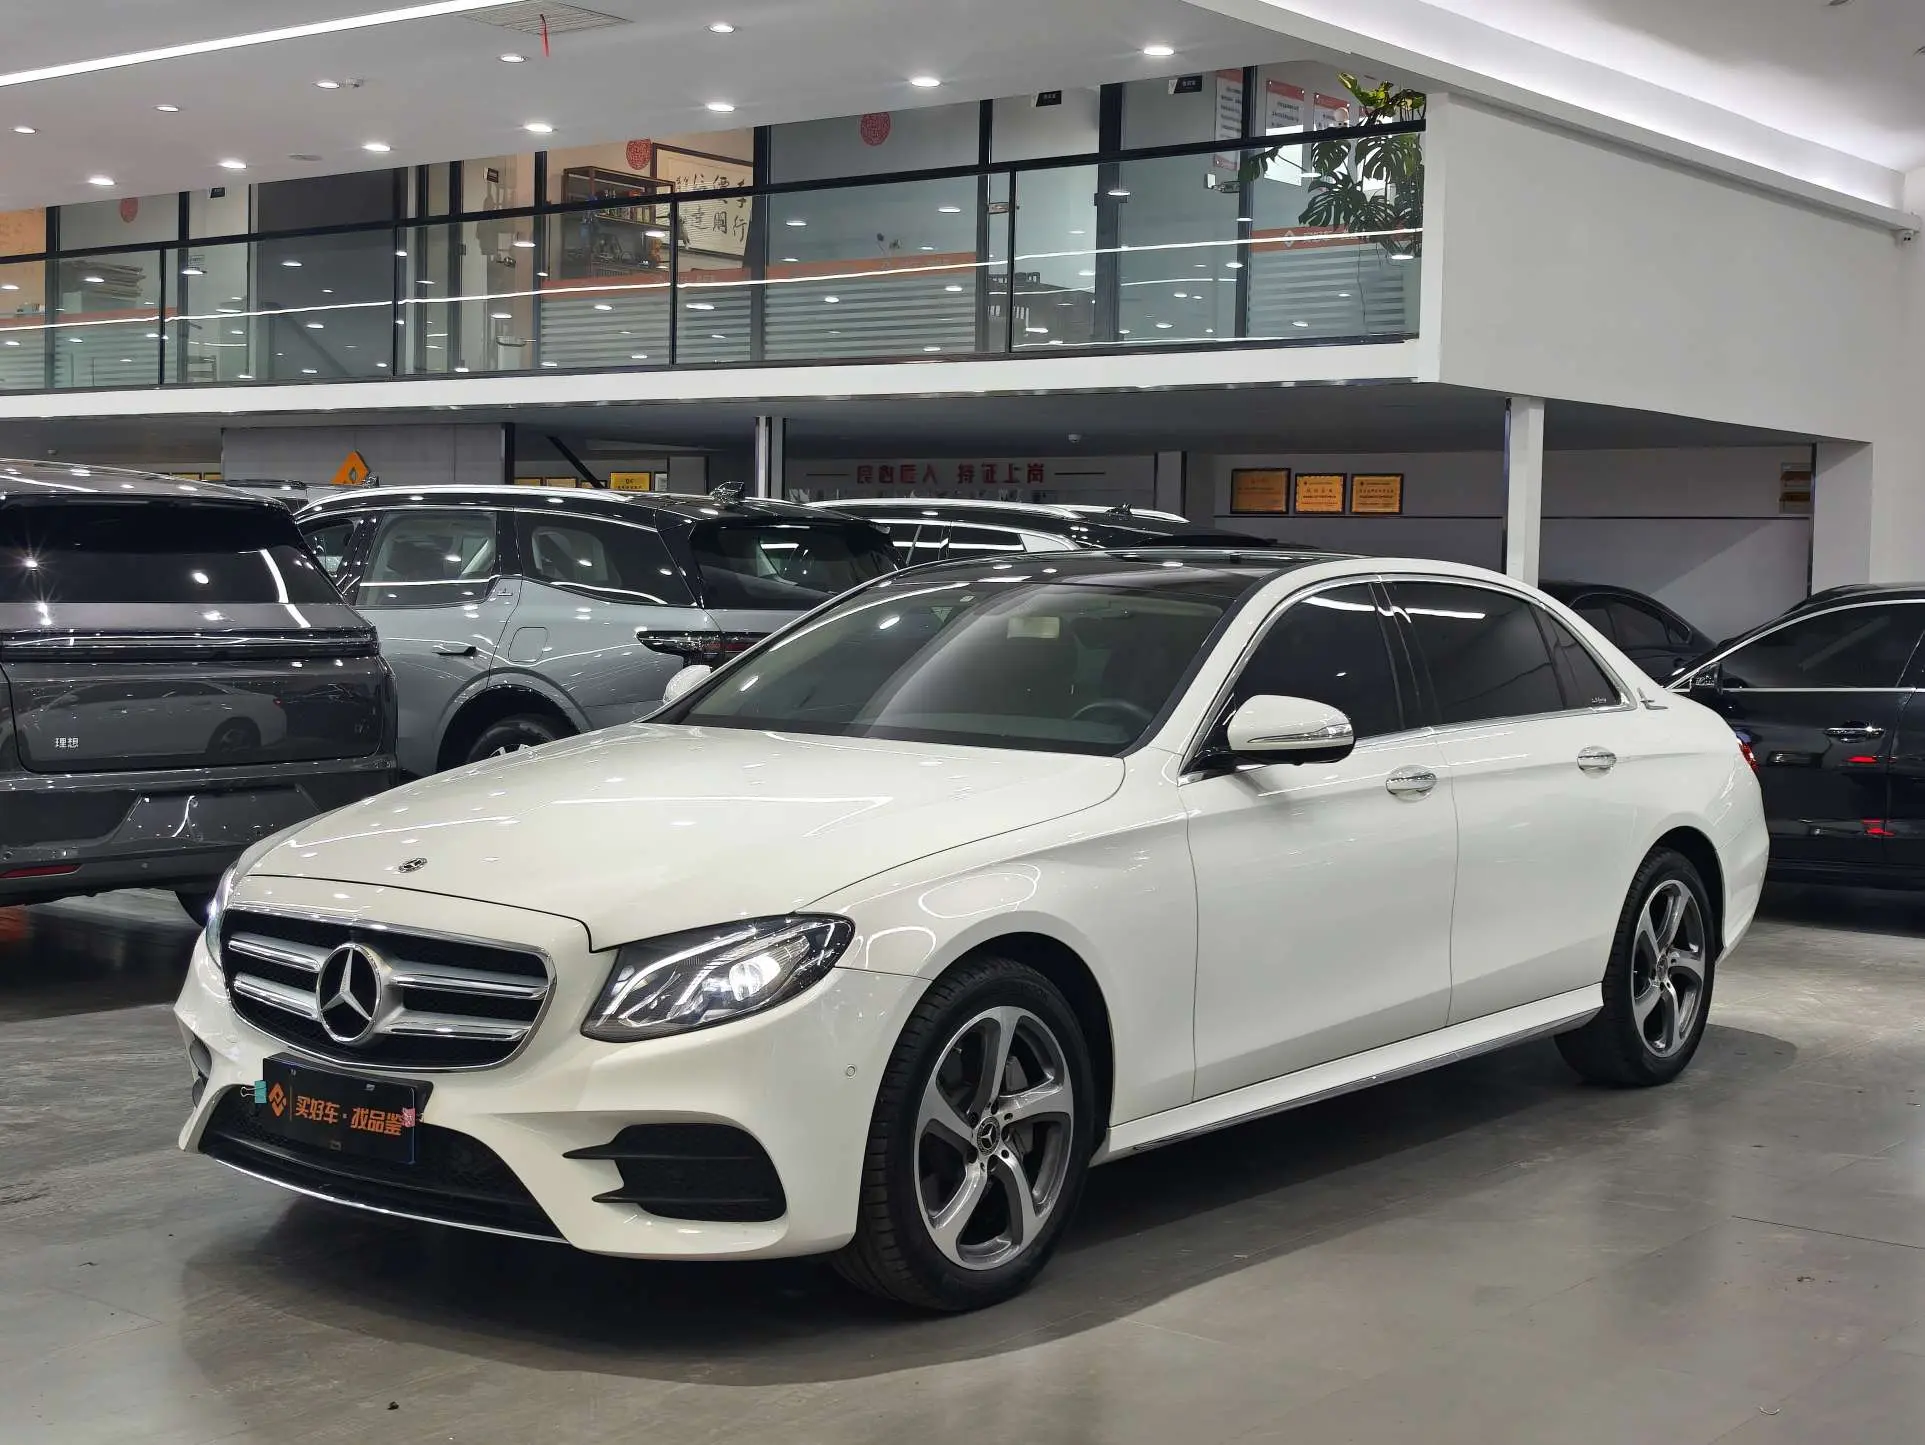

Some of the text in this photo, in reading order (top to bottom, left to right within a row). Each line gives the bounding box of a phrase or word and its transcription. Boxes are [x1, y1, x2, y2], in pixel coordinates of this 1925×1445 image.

[957, 463, 1045, 484] 持证上岗
[55, 737, 79, 748] 理想
